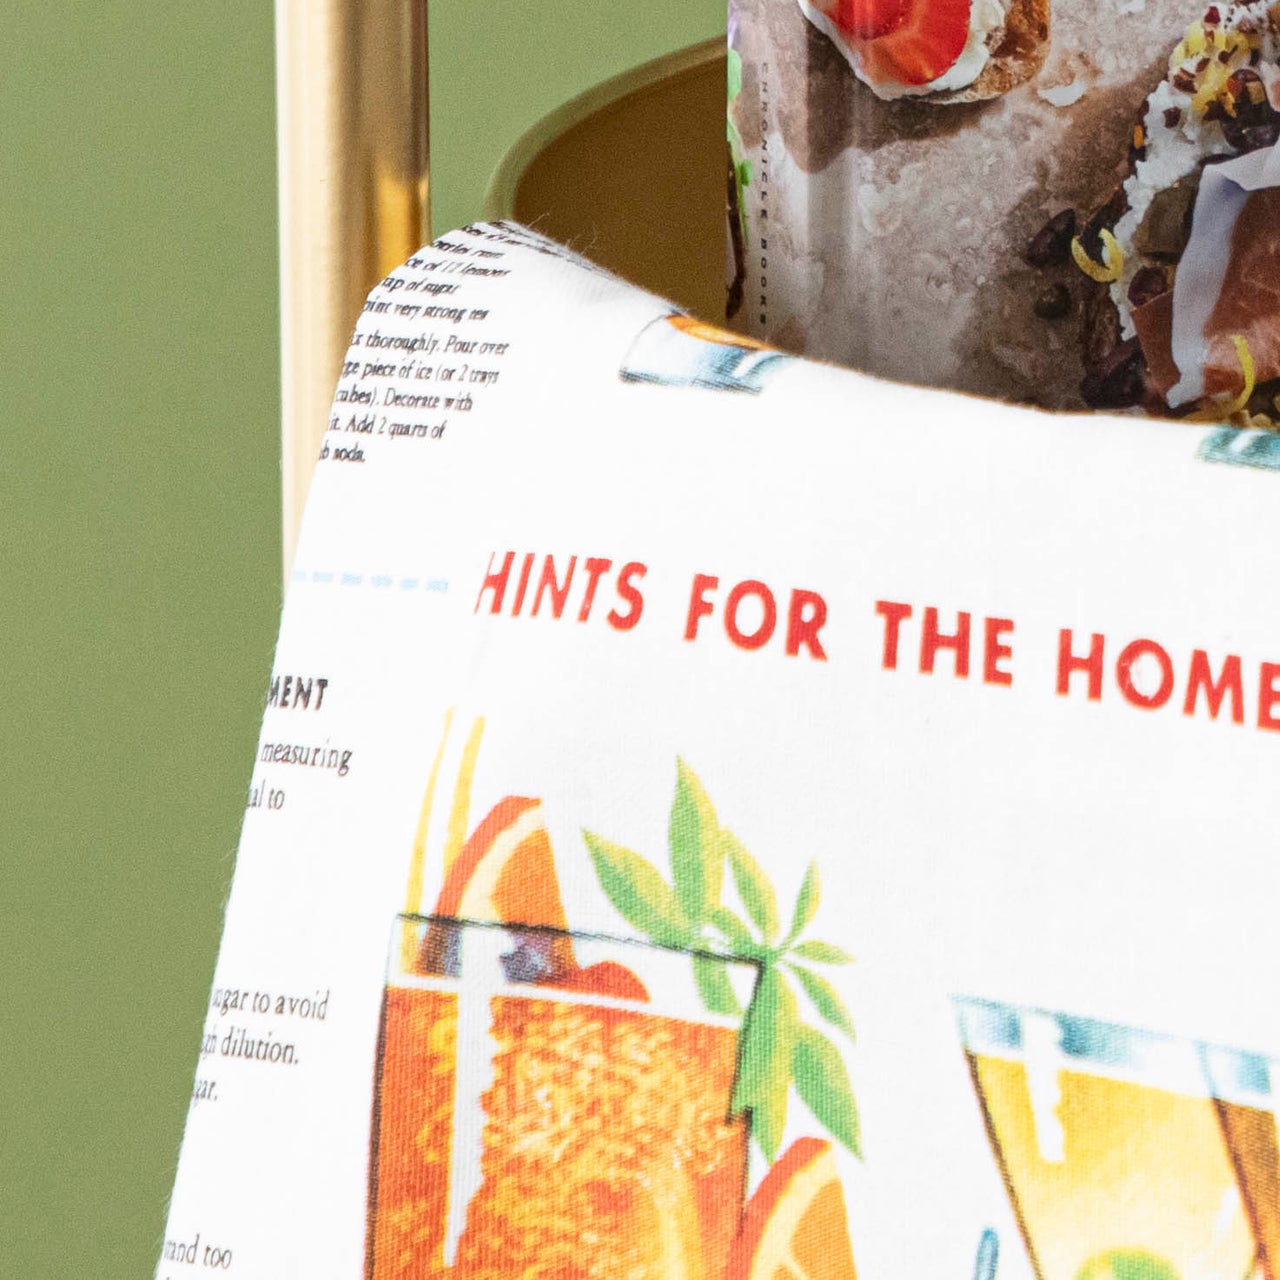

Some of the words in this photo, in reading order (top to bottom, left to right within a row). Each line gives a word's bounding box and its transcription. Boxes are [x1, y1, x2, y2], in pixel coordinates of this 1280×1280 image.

[394, 303, 421, 320] very
[423, 303, 466, 324] strong
[365, 328, 440, 358] thoroughly.
[443, 335, 477, 354] Pour
[479, 341, 509, 355] over
[362, 359, 397, 380] piece
[416, 362, 431, 380] ice
[383, 388, 440, 408] Decorate
[444, 391, 473, 411] with
[346, 414, 376, 434] Add
[388, 421, 427, 440] quarts
[474, 551, 648, 632] HINTS
[683, 572, 828, 662] FOR
[874, 600, 1015, 687] THE
[261, 738, 353, 776] measuring
[268, 788, 285, 810] to
[253, 992, 270, 1014] to
[275, 990, 330, 1021] avoid
[221, 1026, 299, 1065] dilution.
[203, 1244, 233, 1270] too
